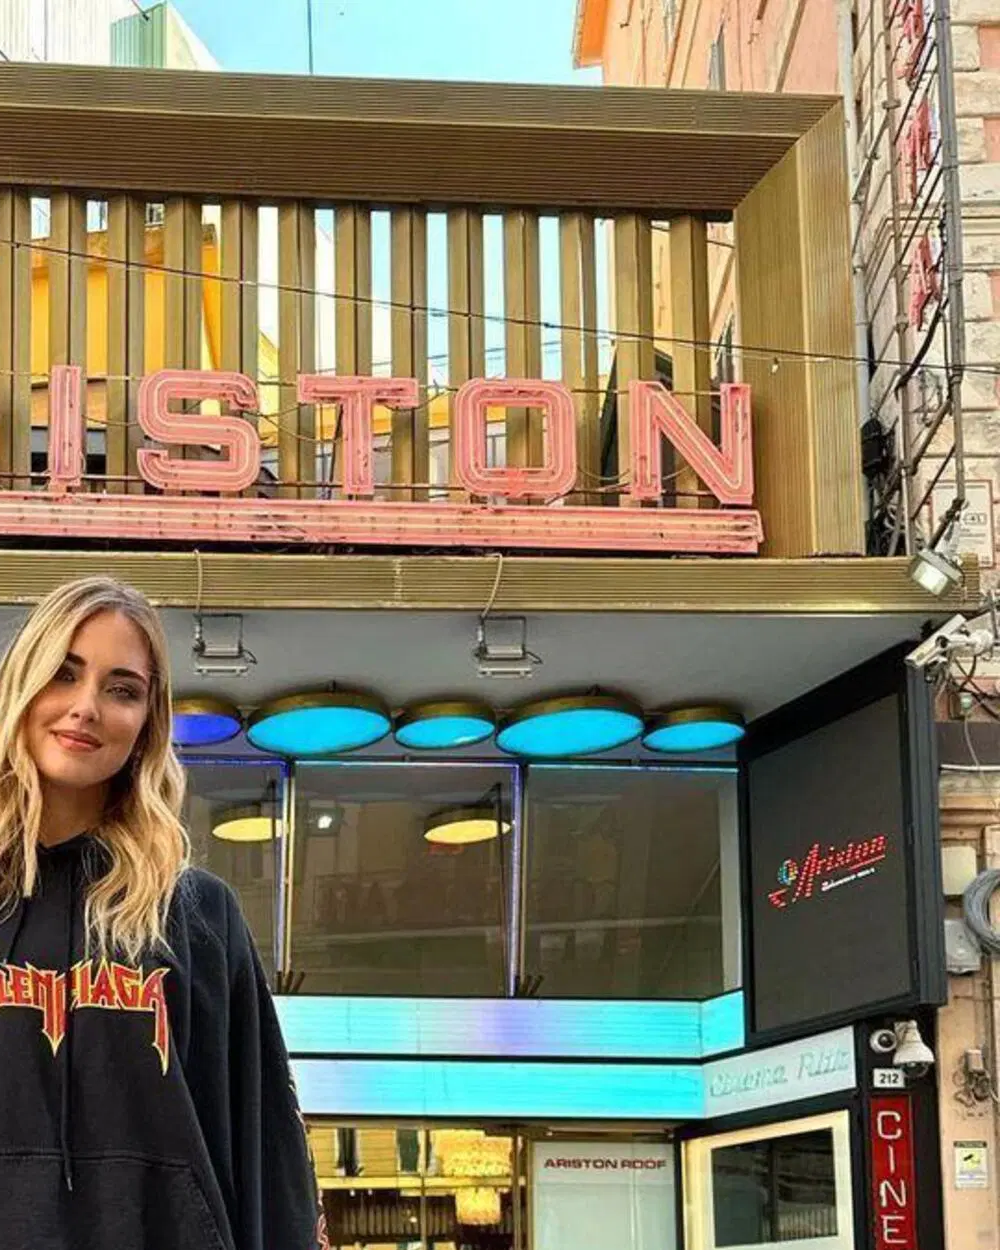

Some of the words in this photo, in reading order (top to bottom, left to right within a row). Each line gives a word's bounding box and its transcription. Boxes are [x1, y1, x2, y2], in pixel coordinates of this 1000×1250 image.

[879, 1073, 899, 1084] 212
[544, 1158, 618, 1169] ARISTON
[621, 1158, 666, 1170] ROOF
